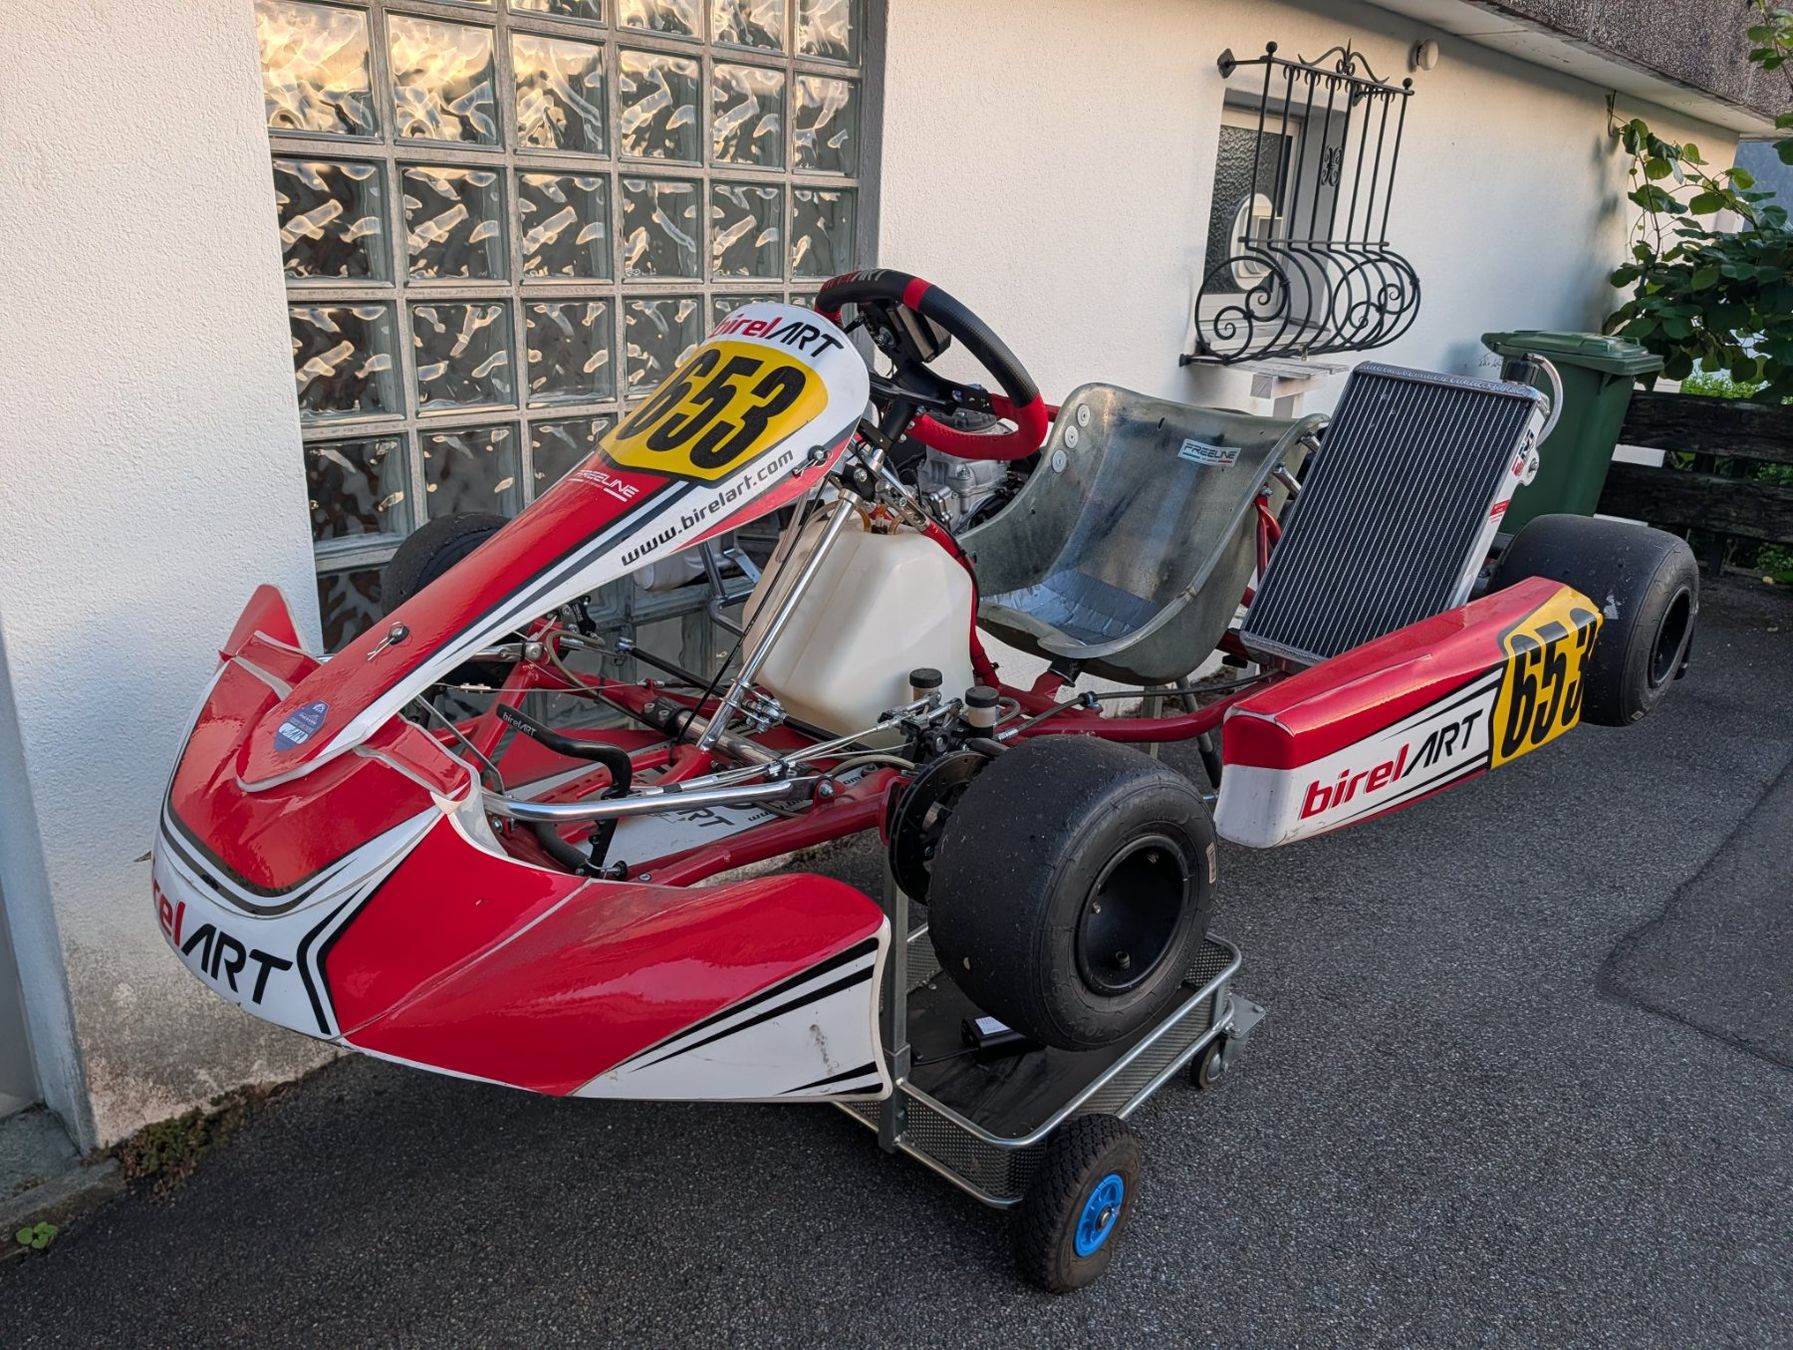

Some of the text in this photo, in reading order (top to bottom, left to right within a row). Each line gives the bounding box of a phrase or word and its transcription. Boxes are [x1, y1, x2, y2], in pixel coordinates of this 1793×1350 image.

[707, 313, 844, 357] birelART
[616, 349, 806, 469] 653
[1184, 442, 1238, 459] FREELINE
[621, 449, 794, 566] www.birelart.com
[1501, 607, 1598, 758] 653
[1298, 708, 1484, 820] birelART
[152, 878, 294, 1005] relART
